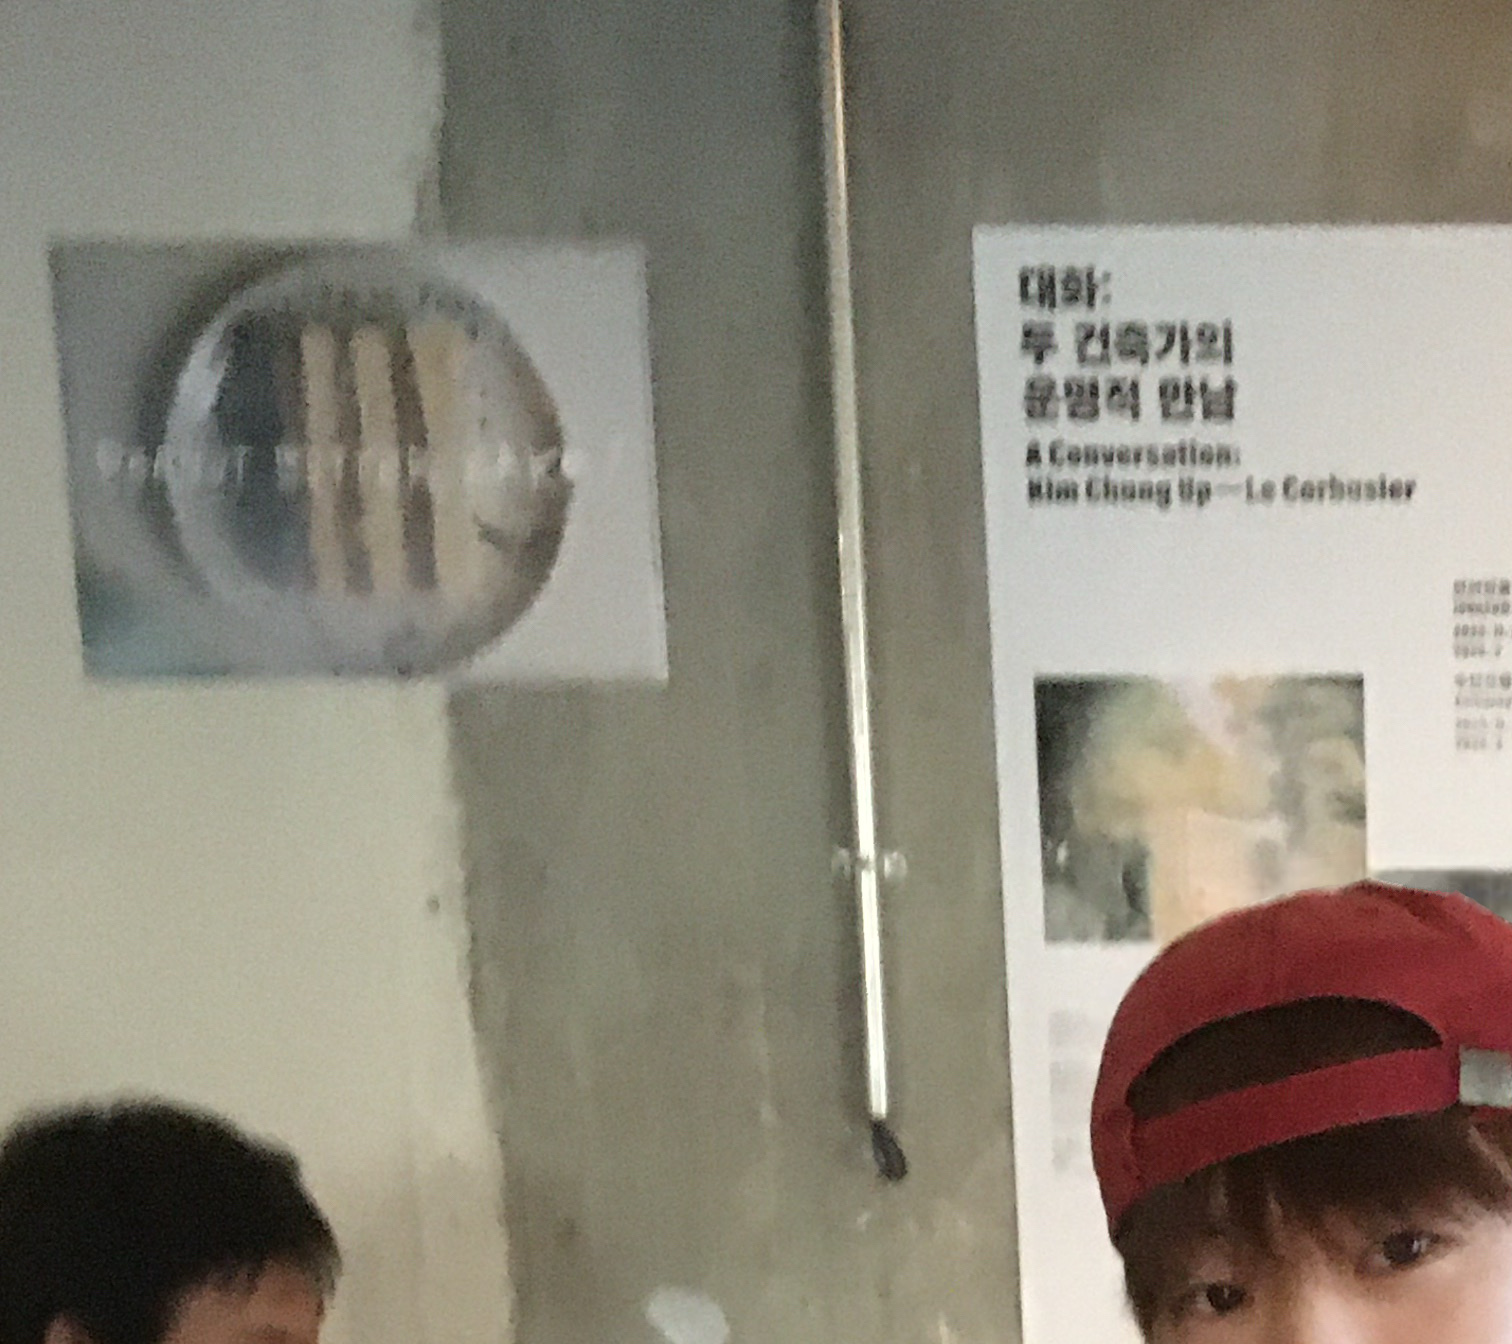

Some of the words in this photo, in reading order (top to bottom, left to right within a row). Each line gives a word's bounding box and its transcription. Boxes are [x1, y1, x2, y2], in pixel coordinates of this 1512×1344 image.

[1017, 263, 1112, 312] 대화:
[1019, 319, 1059, 366] 두
[1074, 319, 1234, 368] 건축가의
[1022, 373, 1142, 423] 운명적
[1157, 373, 1238, 423] 만남
[1027, 476, 1079, 504] Kim
[1084, 474, 1172, 508] Chung
